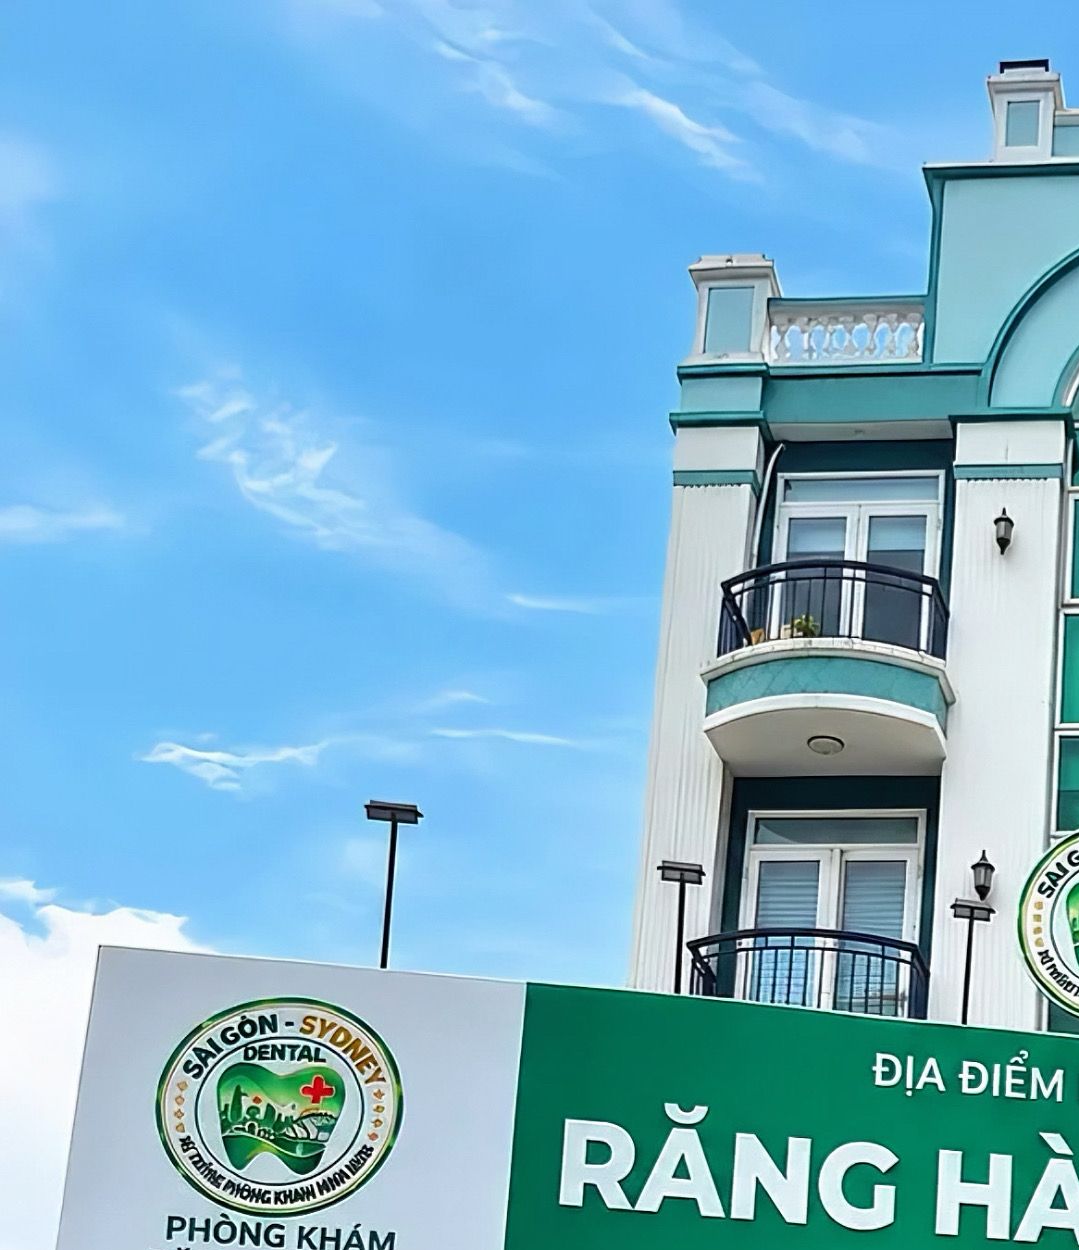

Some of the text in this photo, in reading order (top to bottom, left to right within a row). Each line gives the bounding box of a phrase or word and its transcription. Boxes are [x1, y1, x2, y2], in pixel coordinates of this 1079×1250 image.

[243, 1044, 327, 1063] DENTAL
[299, 1015, 386, 1086] SYDNEY
[872, 1052, 946, 1097] ĐỊA
[958, 1050, 1064, 1102] ĐIỂM
[558, 1103, 899, 1231] RĂNG
[166, 1213, 286, 1249] PHÒNG
